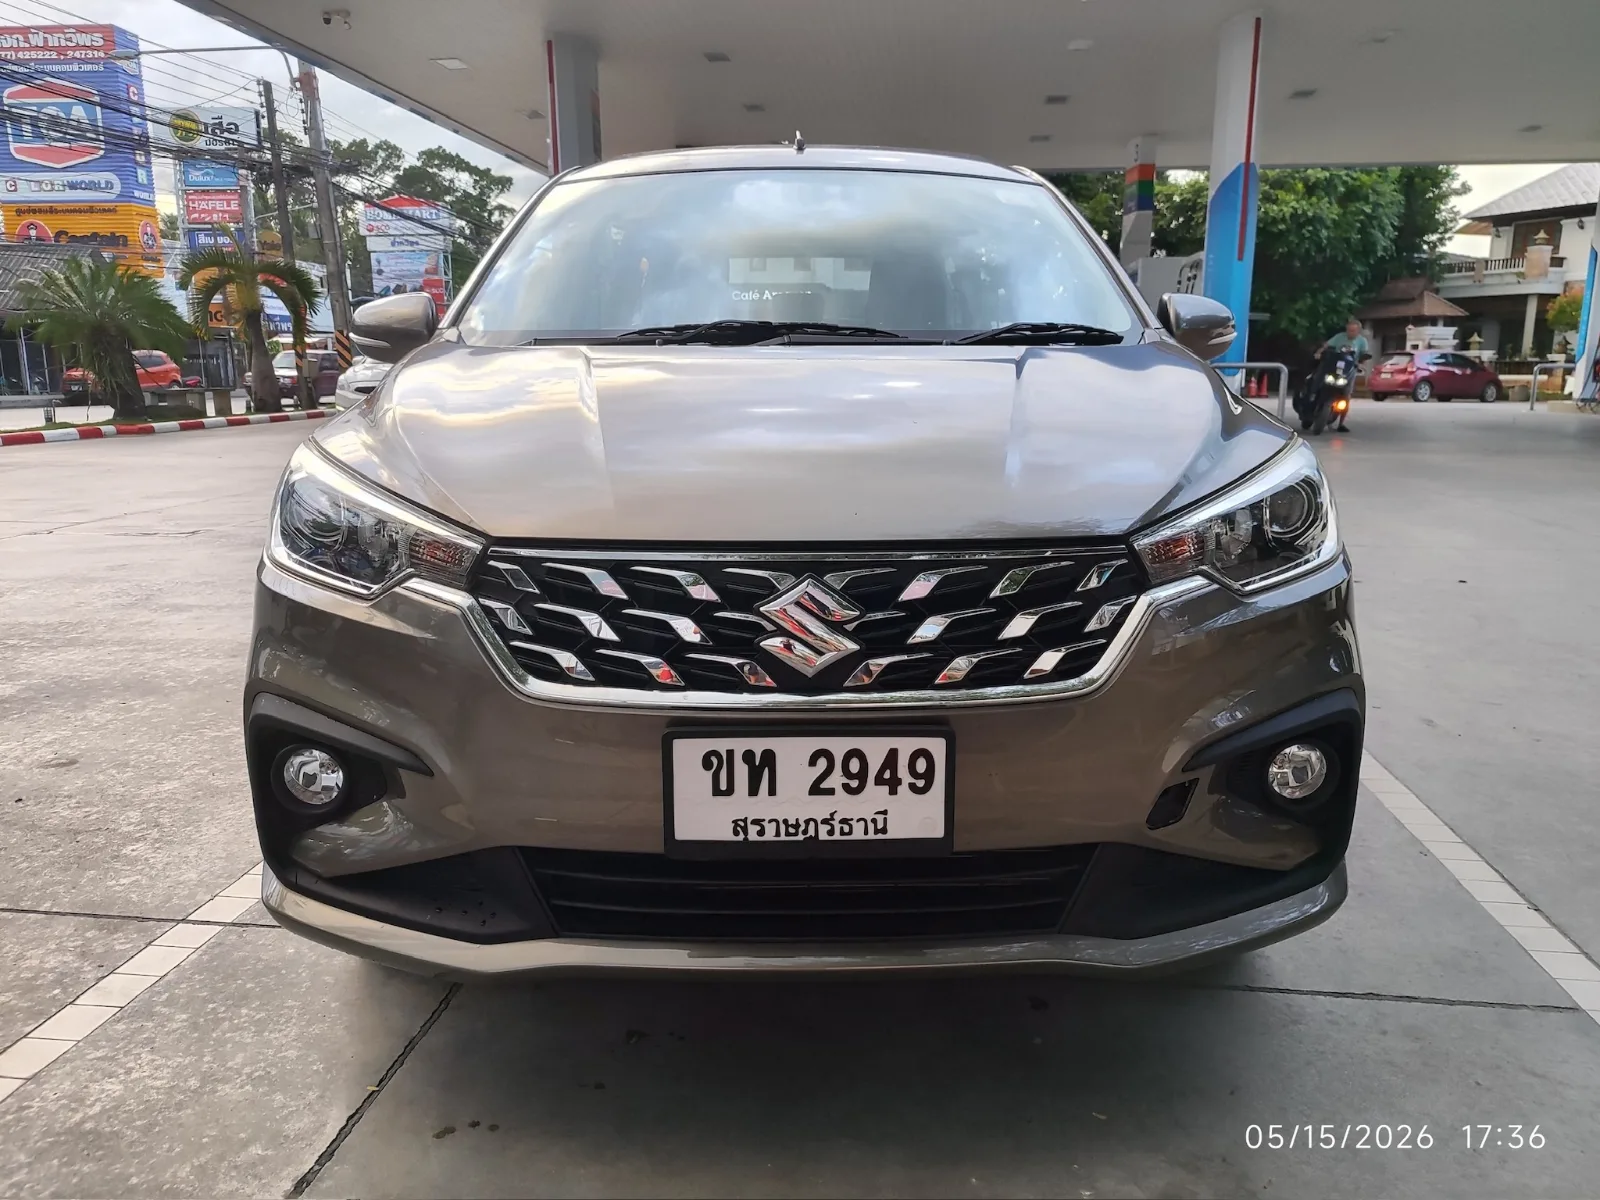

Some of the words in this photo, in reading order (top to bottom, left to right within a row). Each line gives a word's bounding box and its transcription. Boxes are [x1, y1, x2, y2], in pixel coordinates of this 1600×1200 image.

[17, 51, 58, 59] 425222
[189, 174, 212, 182] Dulux
[67, 180, 115, 191] WORLD
[189, 200, 239, 211] HÄFELE
[731, 289, 761, 301] Café
[701, 748, 777, 797] ขท
[807, 747, 936, 796] 2949
[731, 808, 889, 841] สุราษฎร์ธานี
